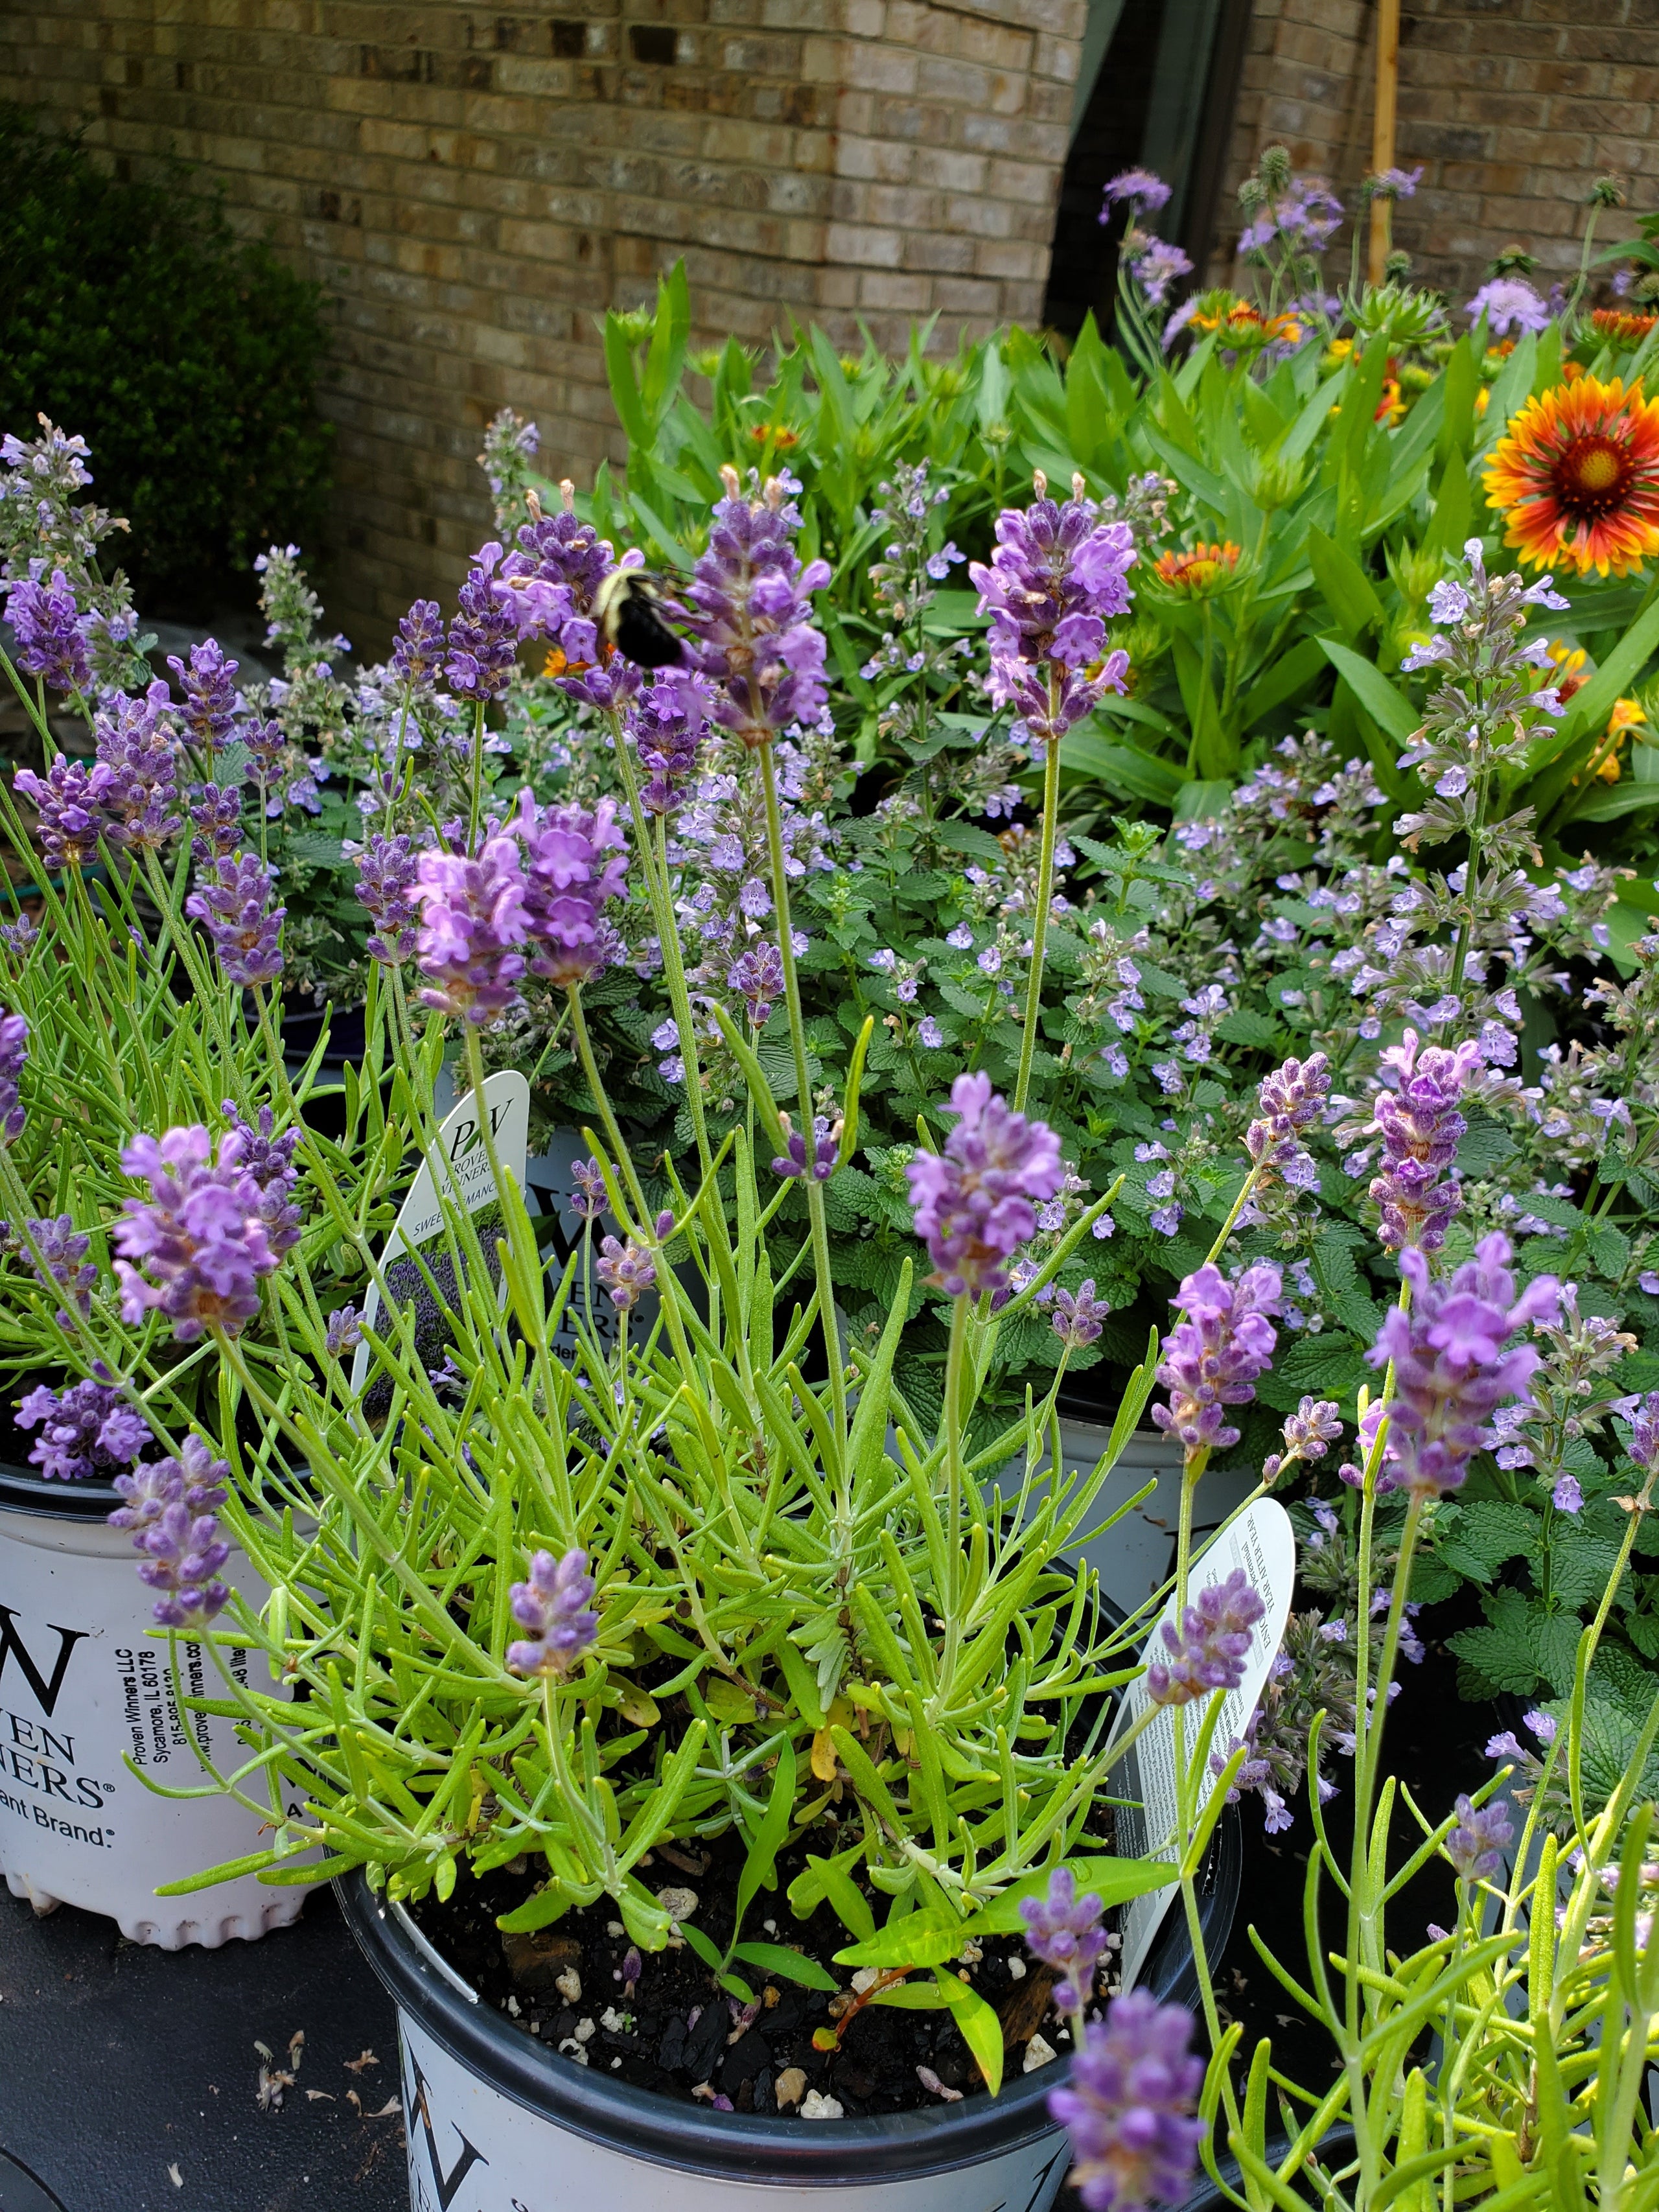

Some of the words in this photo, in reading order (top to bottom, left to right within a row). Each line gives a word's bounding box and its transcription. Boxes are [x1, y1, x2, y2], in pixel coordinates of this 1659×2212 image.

[445, 1150, 488, 1182] ROVE
[413, 1211, 443, 1237] SWEE
[1241, 1538, 1258, 1591] perennial
[1253, 1543, 1267, 1584] AFTER
[1262, 1578, 1275, 1614] YEAR
[1259, 1612, 1271, 1651] ENJO
[115, 1648, 135, 1673] LLC
[139, 1651, 158, 1688] 60178
[122, 1675, 141, 1723] Winners
[145, 1690, 161, 1701] IL
[130, 1725, 148, 1765] Proven
[149, 1704, 171, 1764] Sycamore,
